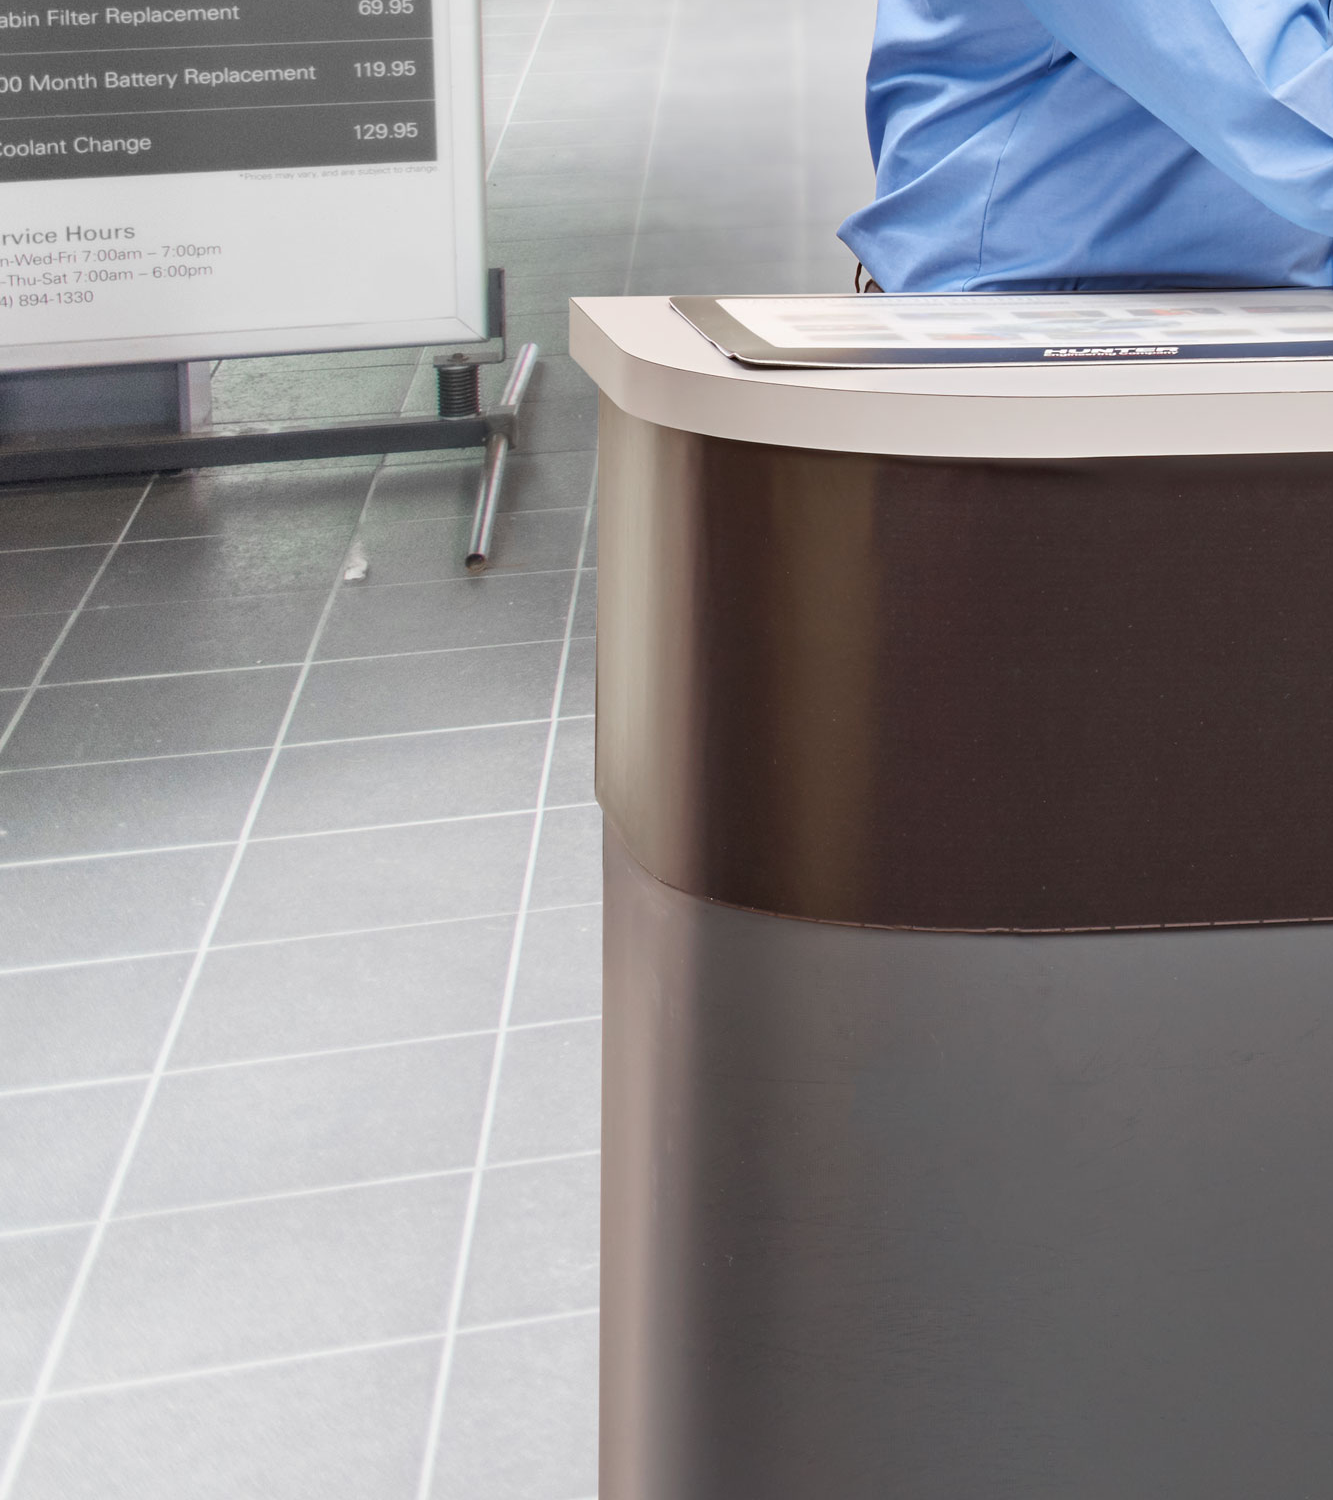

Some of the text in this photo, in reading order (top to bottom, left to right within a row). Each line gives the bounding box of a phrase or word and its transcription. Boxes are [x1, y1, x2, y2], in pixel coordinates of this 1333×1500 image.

[47, 9, 99, 26] Filter
[105, 5, 241, 27] Replacement
[29, 73, 97, 91] Month
[105, 71, 178, 89] Battery
[184, 65, 316, 87] Replacement
[353, 60, 417, 78] 119.95
[353, 122, 419, 140] 129.95
[0, 136, 152, 157] oolant Change
[66, 225, 136, 242] Hours
[81, 248, 143, 263] 7:00am
[161, 243, 222, 259] 7:00pm
[73, 268, 134, 283] 7:00am
[152, 263, 214, 280] 6:00pm
[19, 290, 95, 307] 894-1330
